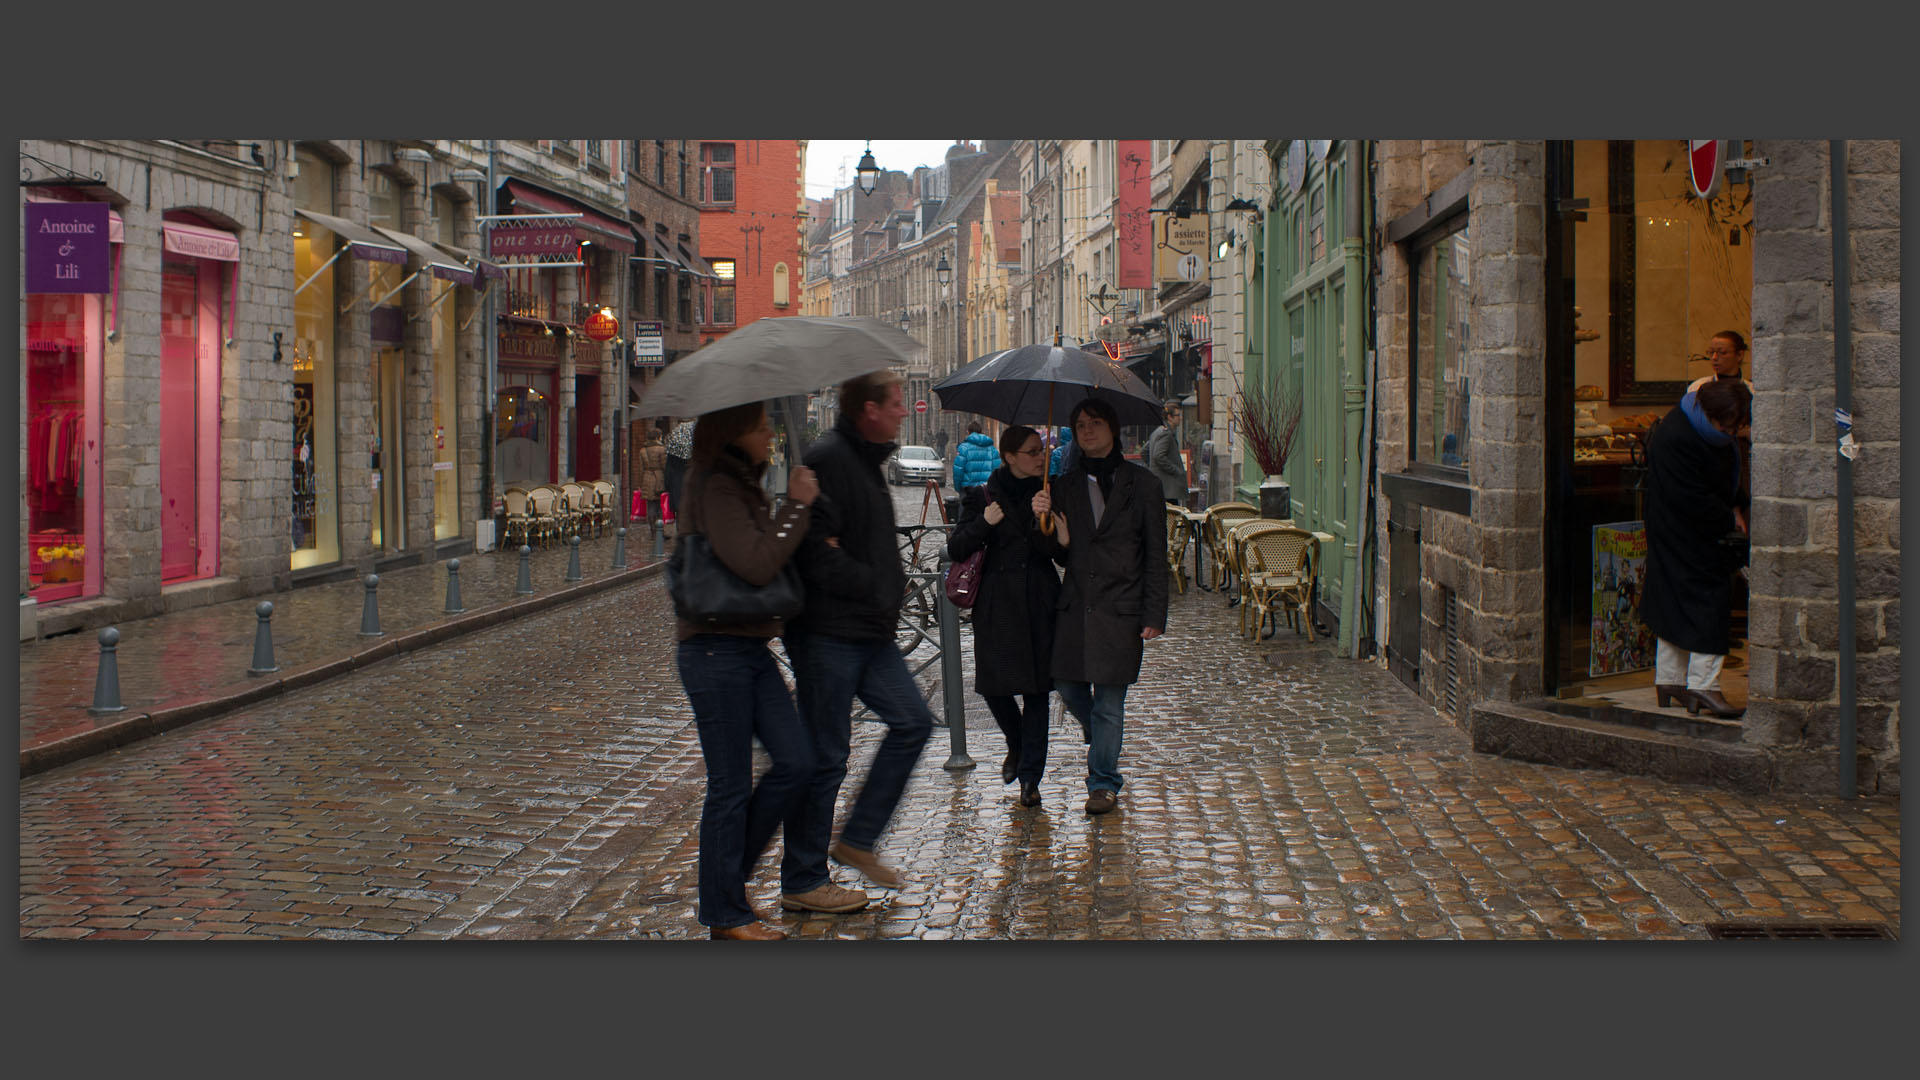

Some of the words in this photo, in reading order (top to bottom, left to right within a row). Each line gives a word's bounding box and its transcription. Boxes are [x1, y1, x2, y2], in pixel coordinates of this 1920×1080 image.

[39, 218, 96, 234] Antoine
[58, 239, 75, 257] &
[176, 236, 207, 254] Antoine
[216, 243, 232, 258] Lili
[493, 234, 527, 248] one
[534, 233, 573, 248] step
[56, 264, 80, 280] Lili
[597, 316, 605, 324] LA
